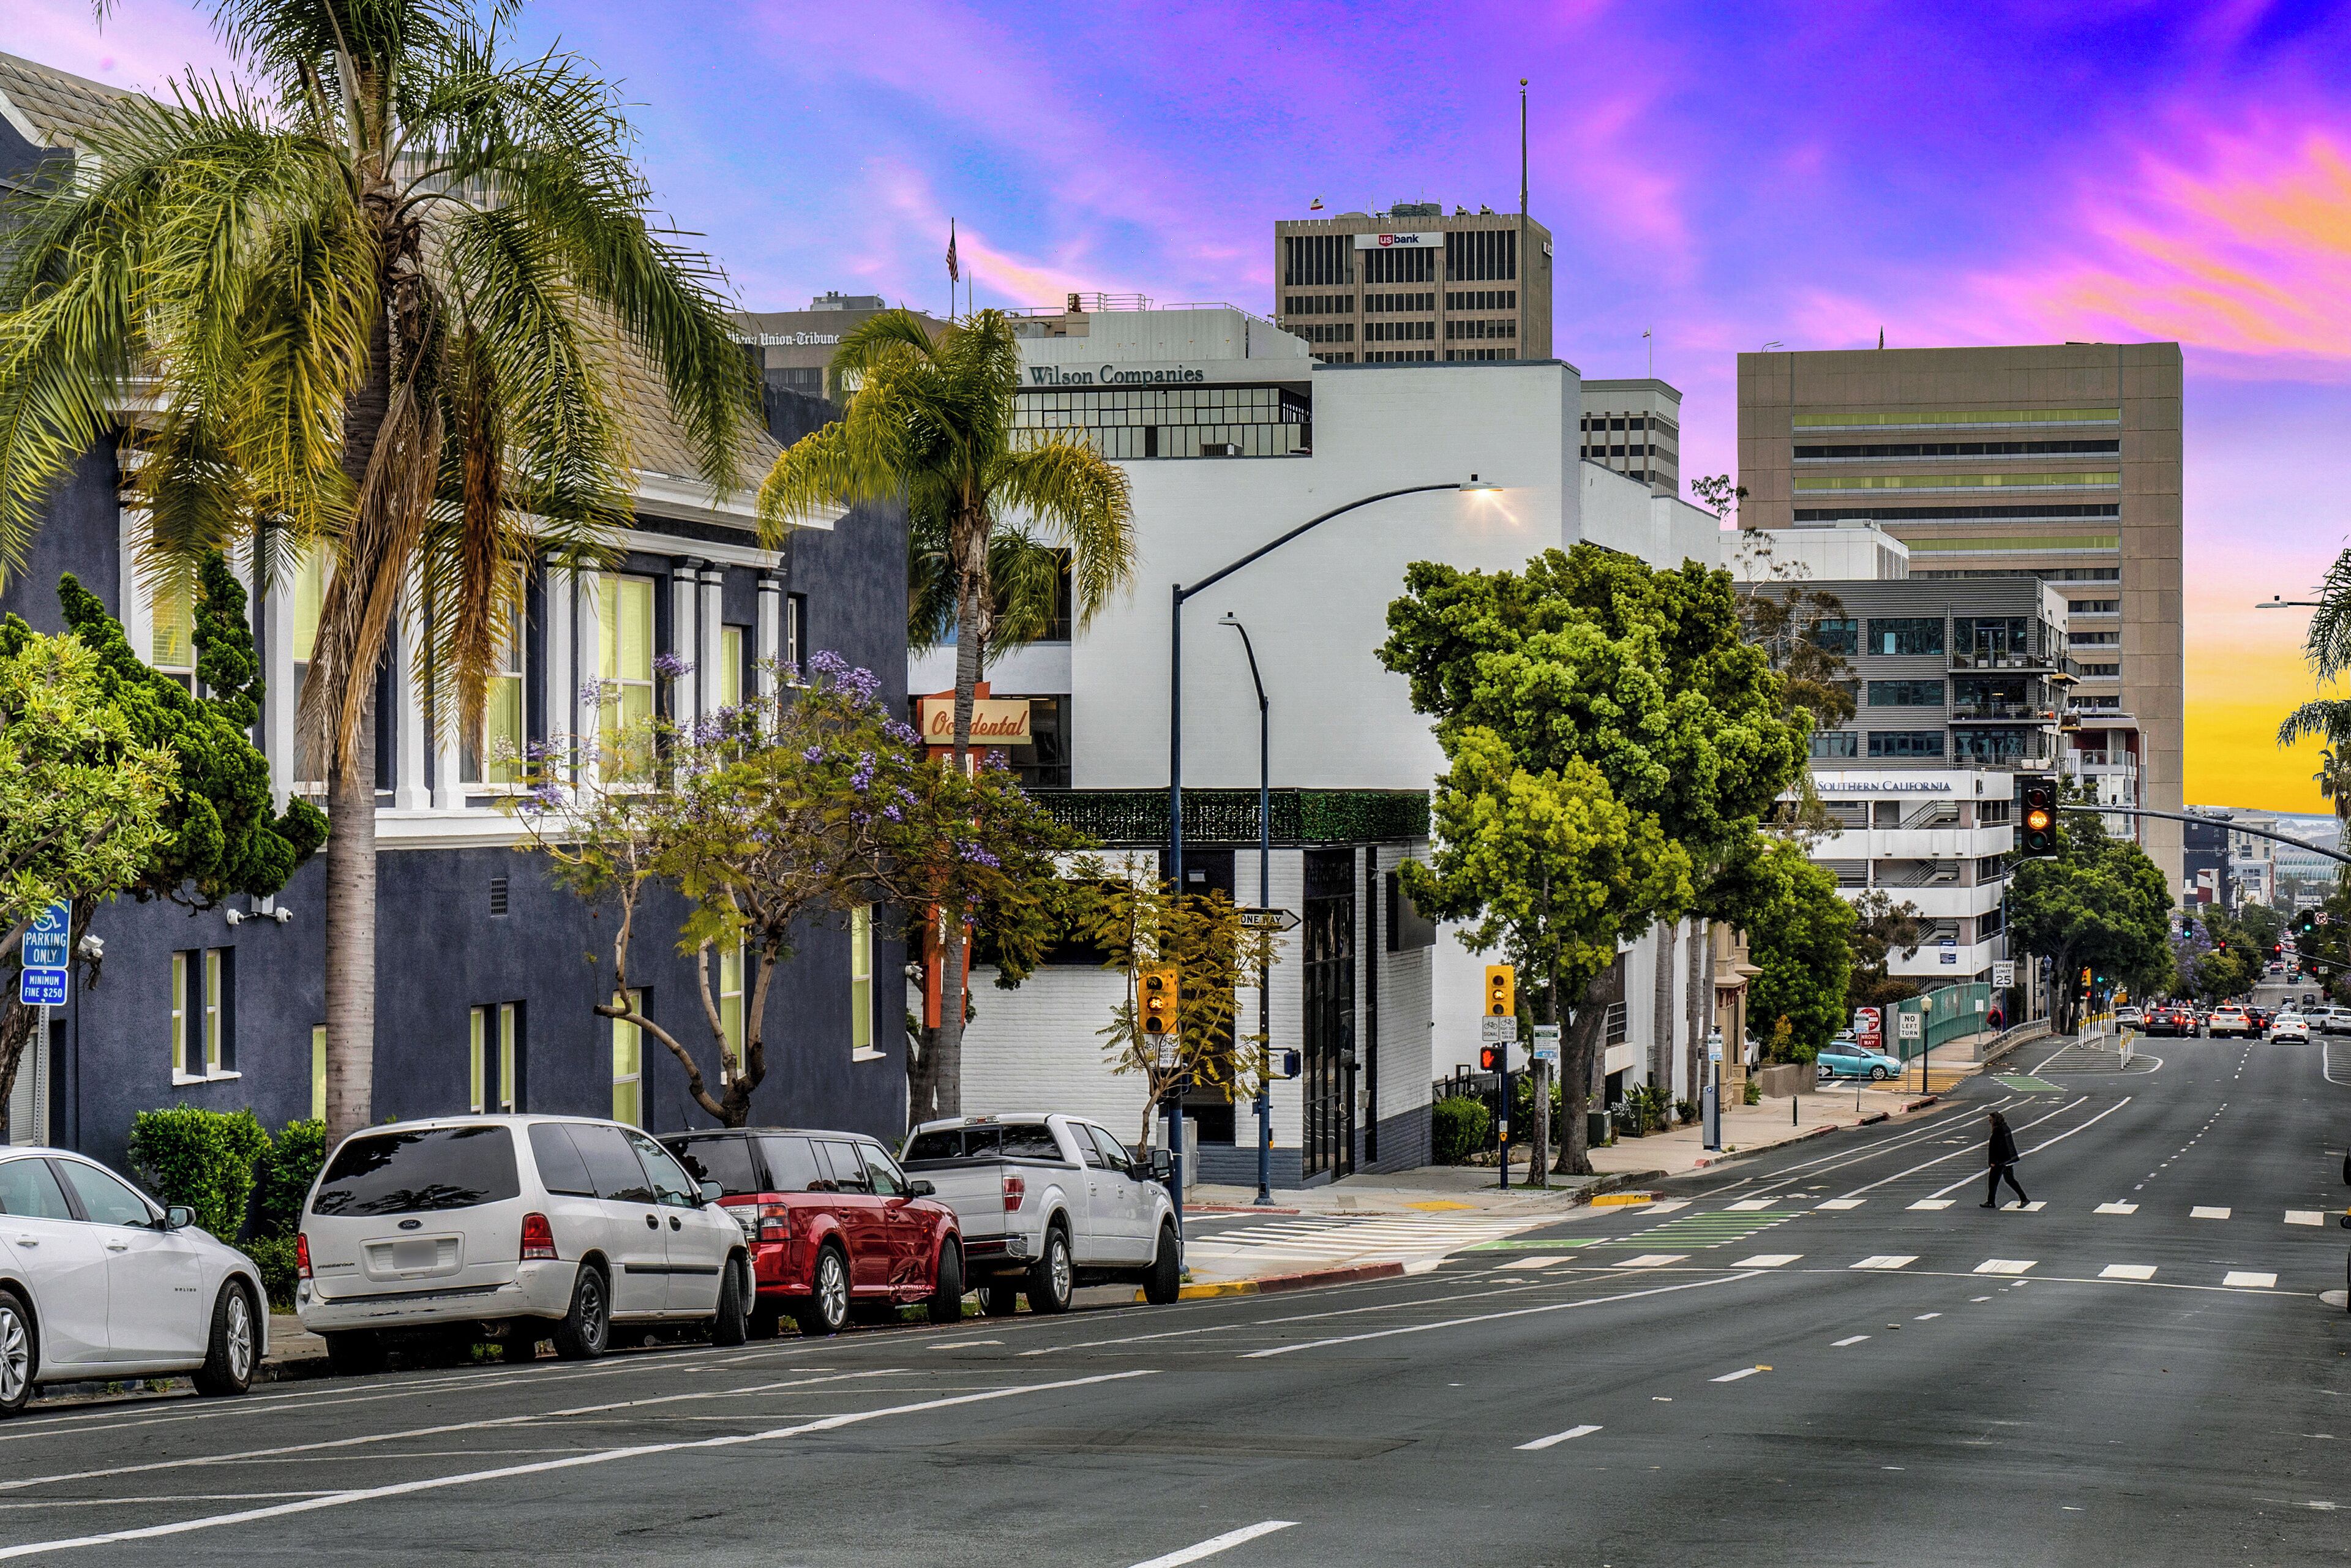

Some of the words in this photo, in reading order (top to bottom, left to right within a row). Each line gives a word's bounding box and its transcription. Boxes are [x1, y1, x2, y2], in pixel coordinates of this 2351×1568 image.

[759, 331, 840, 346] Union-Tribune
[1029, 365, 1093, 385] Wilson
[1100, 364, 1204, 388] Companies
[932, 710, 1028, 735] Ocdental
[1883, 781, 1951, 790] CALIFORNIA
[1240, 915, 1259, 923] ONE
[1262, 915, 1282, 924] WAY
[26, 932, 67, 947] PARKING
[33, 949, 58, 962] ONLY
[29, 975, 59, 986] MINIMUM
[1996, 975, 2011, 985] 25
[24, 987, 40, 997] FINE
[43, 988, 62, 998] $250
